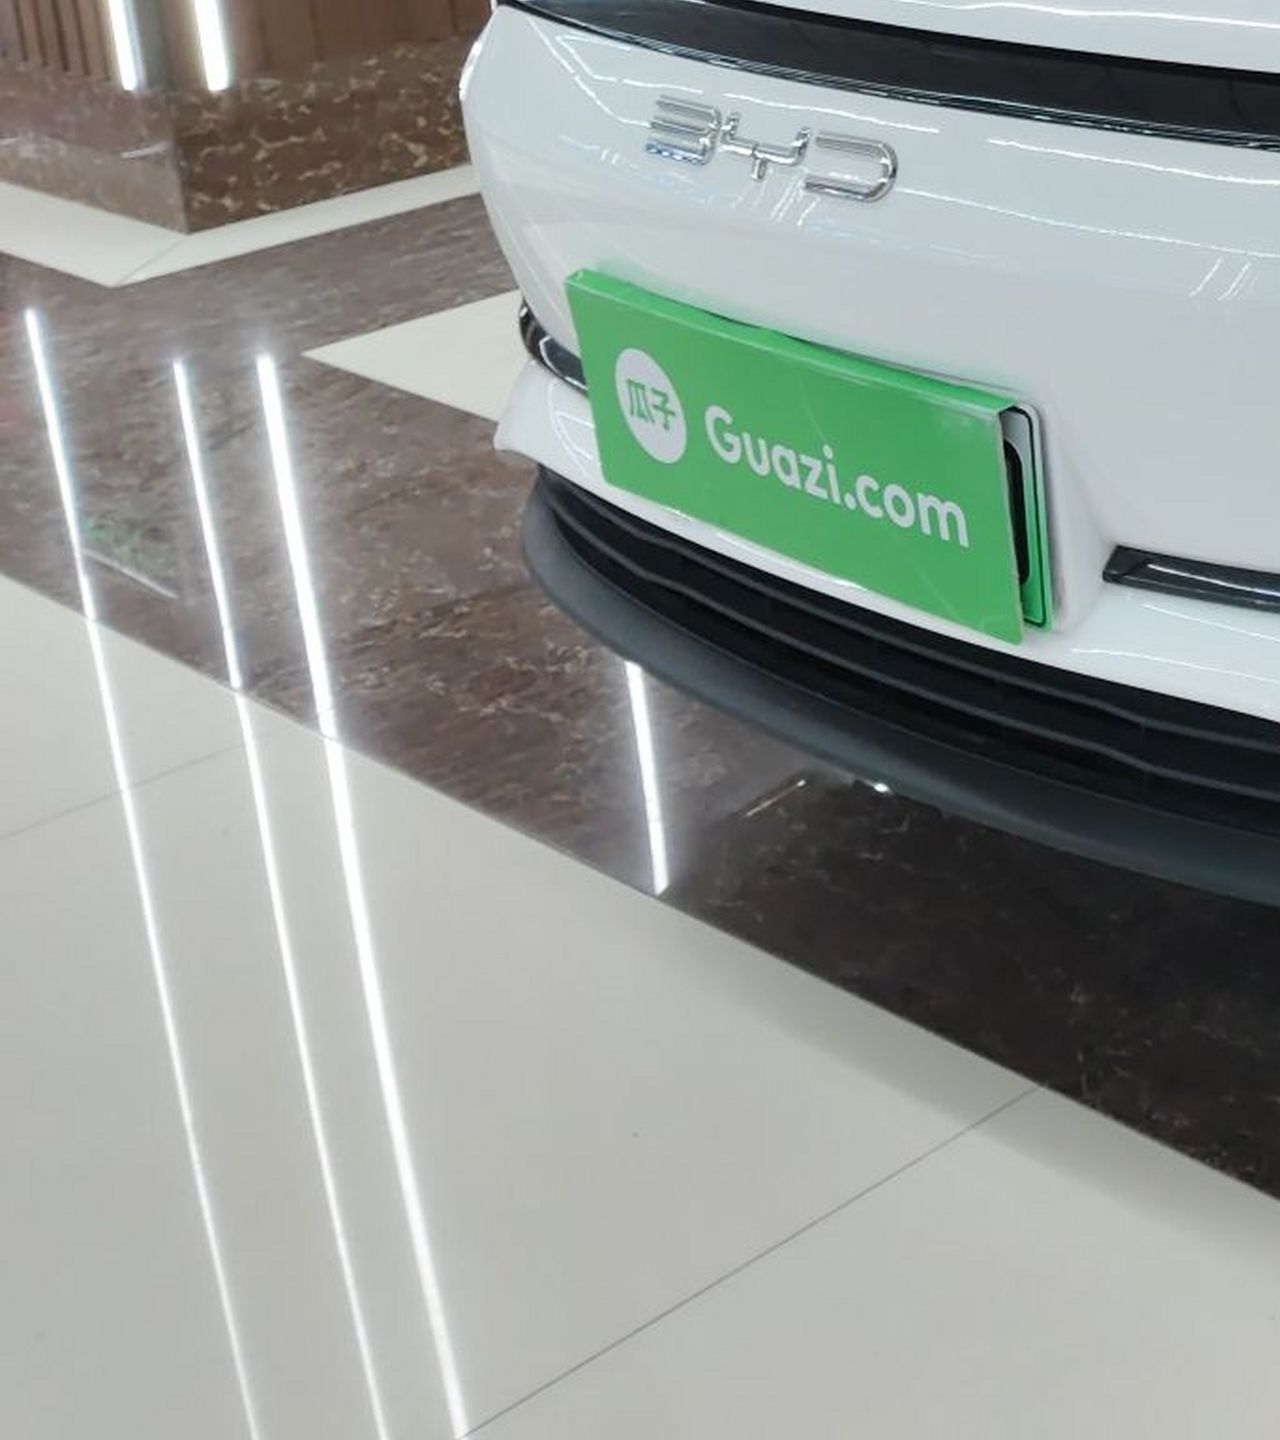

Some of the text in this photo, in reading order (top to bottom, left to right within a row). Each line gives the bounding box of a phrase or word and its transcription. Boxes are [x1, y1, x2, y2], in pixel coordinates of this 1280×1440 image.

[644, 94, 898, 203] BYD
[625, 378, 678, 432] 瓜子
[704, 403, 970, 549] Guazi.com
